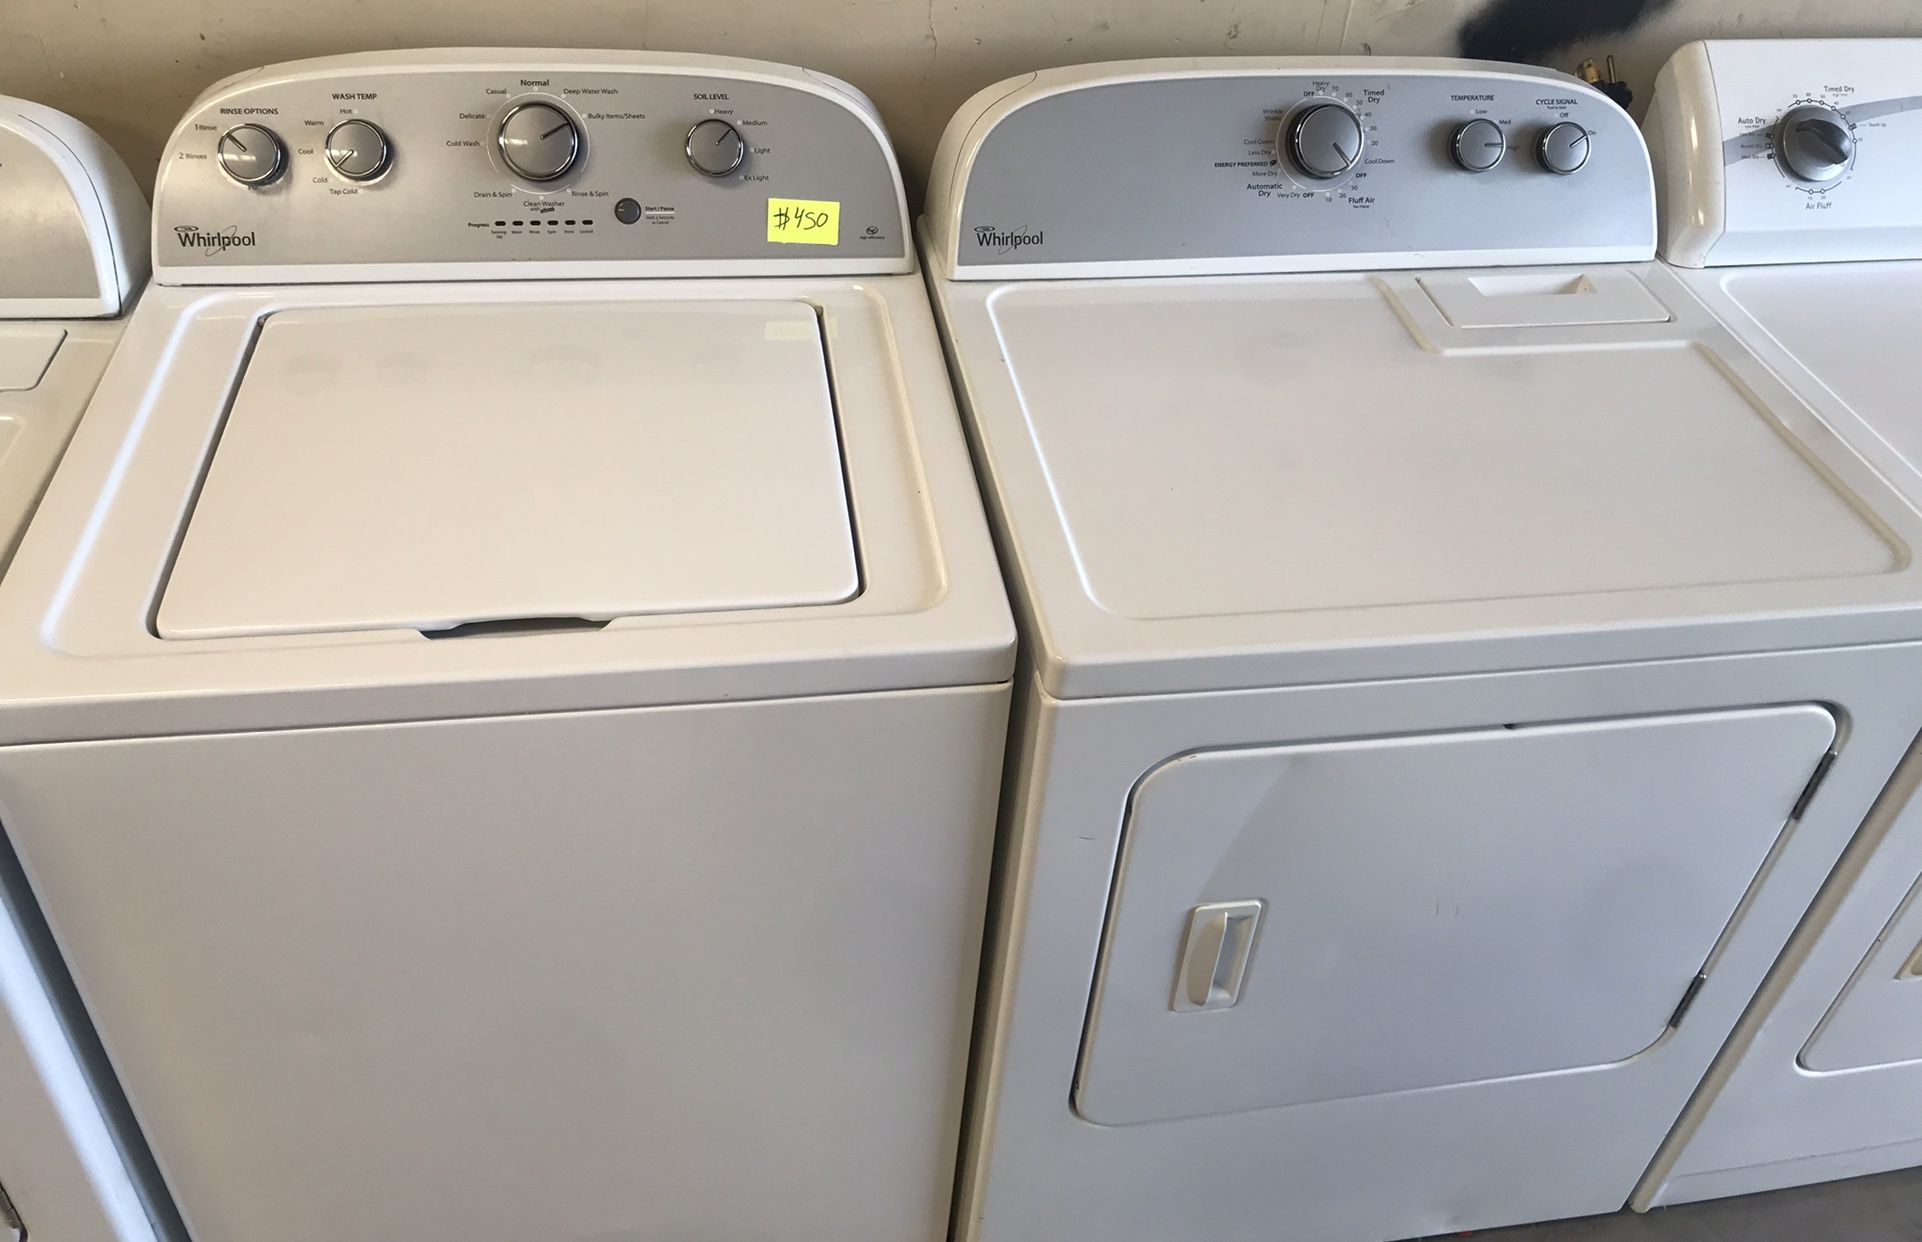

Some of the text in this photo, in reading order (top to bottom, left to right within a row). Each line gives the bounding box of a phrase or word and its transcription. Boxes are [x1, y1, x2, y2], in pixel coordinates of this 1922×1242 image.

[520, 79, 550, 87] Normal
[714, 108, 734, 116] Heavy
[1755, 116, 1766, 124] Dry
[754, 147, 771, 155] Light
[753, 174, 769, 182] Light
[498, 191, 512, 199] Spin
[595, 190, 609, 199] Spin
[1258, 190, 1271, 198] Dry
[1805, 202, 1832, 210] Air Fluff
[773, 207, 829, 231] $450
[177, 232, 256, 251] Whirlpool
[977, 231, 1043, 250] Whirlpool
